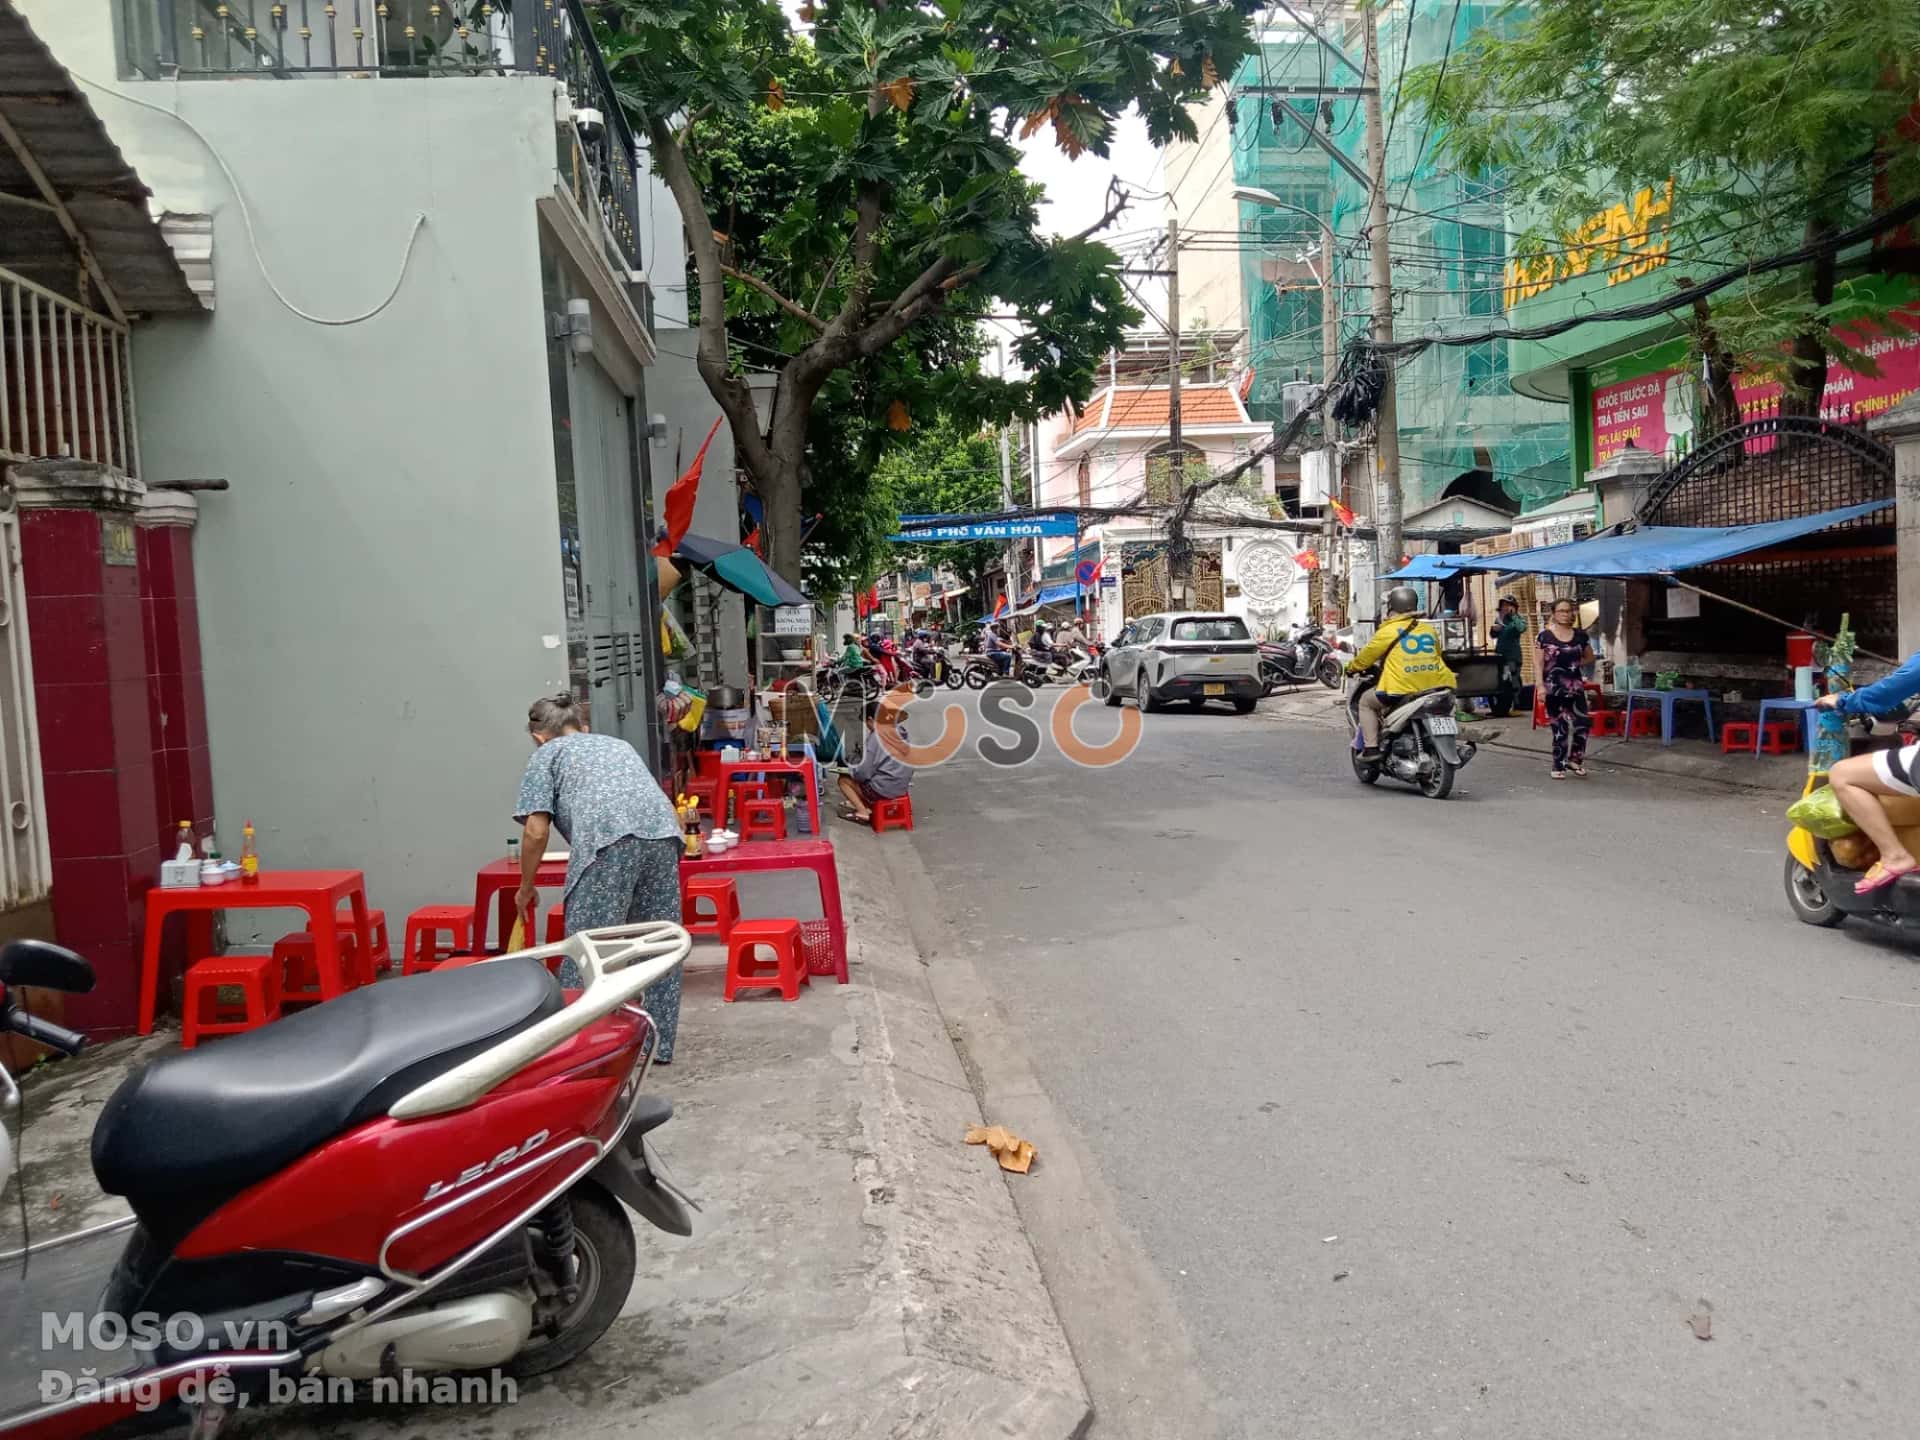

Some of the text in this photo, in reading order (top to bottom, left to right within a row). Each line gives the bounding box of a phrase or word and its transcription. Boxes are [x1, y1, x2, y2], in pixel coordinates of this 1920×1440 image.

[1631, 405, 1649, 419] SAU
[1397, 627, 1435, 655] be
[424, 1128, 550, 1201] LEAD
